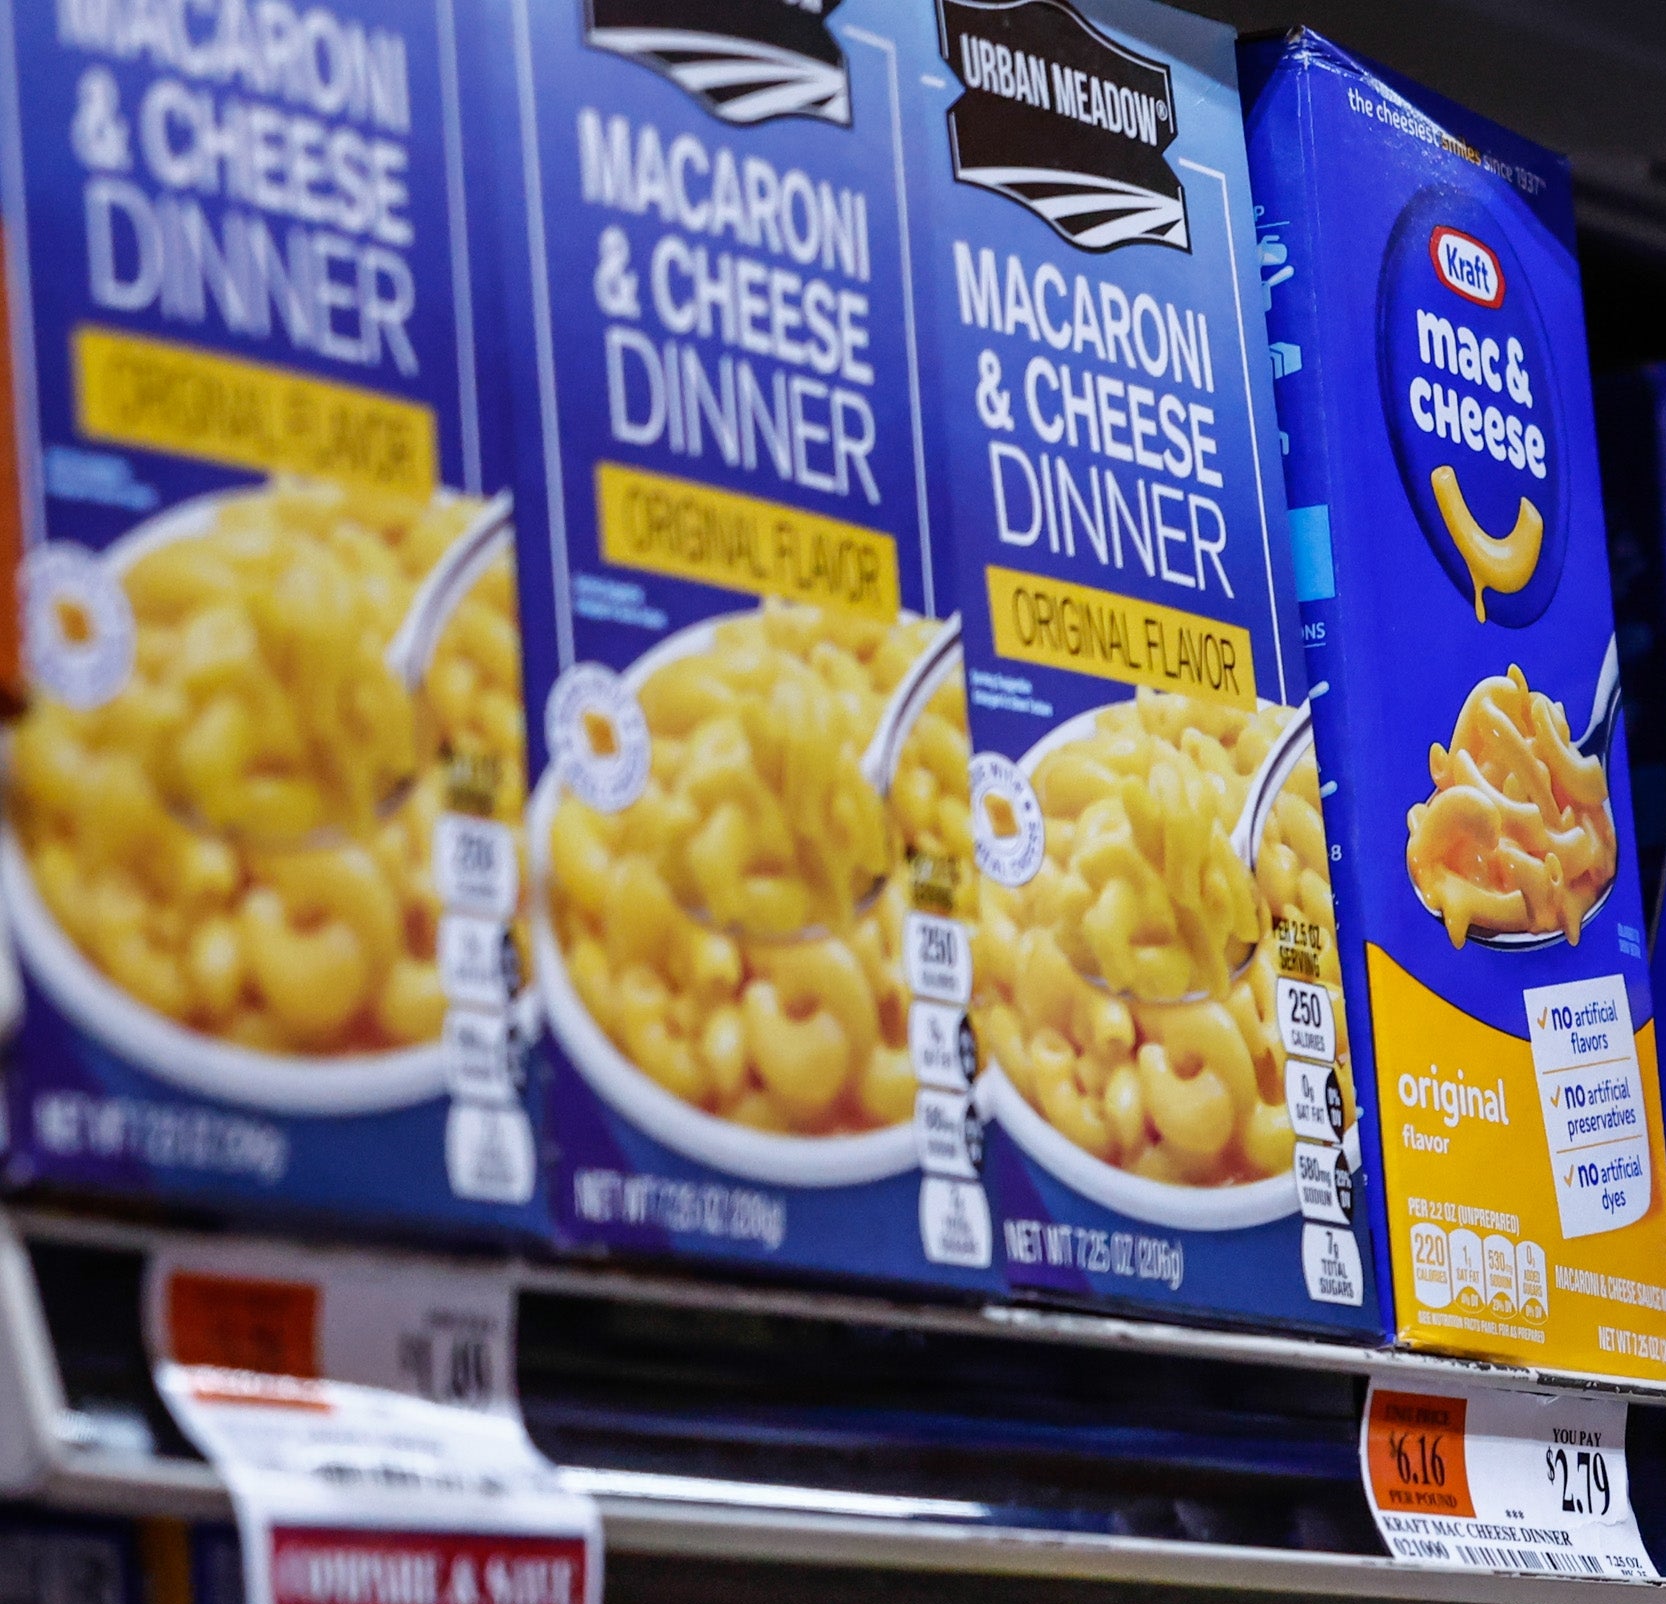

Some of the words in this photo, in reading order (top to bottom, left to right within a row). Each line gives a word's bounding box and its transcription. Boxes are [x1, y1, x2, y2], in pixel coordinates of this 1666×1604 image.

[960, 33, 1049, 110] URBAN
[1348, 88, 1373, 117] the
[1376, 101, 1440, 147] cheesiest
[1483, 150, 1513, 183] since
[70, 66, 132, 172] &
[140, 78, 414, 246] CHEESE
[577, 106, 870, 282] MACARONI
[85, 175, 420, 378] DINNER
[1446, 244, 1490, 294] Kraft
[593, 226, 640, 318] &
[650, 236, 874, 385] CHEESE
[953, 240, 1214, 393] MACARONI
[1416, 308, 1502, 392] mac
[1506, 336, 1532, 409] &
[605, 325, 881, 504] DINNER
[976, 349, 1015, 432] &
[1025, 356, 1224, 488] CHEESE
[989, 440, 1234, 599] DINNER
[1012, 587, 1142, 669] ORIGINAL
[1144, 618, 1240, 696] FLAVOR
[1280, 947, 1320, 978] SERVING
[1288, 987, 1323, 1028] 250
[1551, 1005, 1573, 1031] no
[1574, 999, 1618, 1027] artificial
[1291, 1030, 1326, 1052] CALORIES
[1571, 1032, 1608, 1055] flavors
[1398, 1064, 1510, 1128] original
[1565, 1083, 1586, 1110] no
[1587, 1076, 1631, 1106] artificial
[1402, 1123, 1450, 1155] flavor
[1567, 1107, 1636, 1142] preservatives
[1578, 1161, 1599, 1188] no
[1601, 1155, 1643, 1184] artificial
[1408, 1197, 1428, 1218] PER
[1428, 1200, 1443, 1221] 2.2
[1444, 1203, 1457, 1222] OZ
[1458, 1205, 1520, 1237] (UNPREPARED)
[1602, 1188, 1627, 1216] dyes
[1003, 1218, 1042, 1263] NET
[1414, 1233, 1446, 1266] 220
[1319, 1276, 1353, 1300] SUGARS
[1321, 1257, 1347, 1281] TOTAL
[1555, 1265, 1599, 1297] MACARONI
[1608, 1277, 1636, 1302] CHEESE
[1599, 1326, 1615, 1351] NET
[1616, 1329, 1631, 1353] WT
[1553, 1428, 1577, 1445] YOU
[1579, 1430, 1602, 1447] PAY
[1389, 1430, 1446, 1487] $6.16
[1389, 1489, 1415, 1506] PER
[1416, 1491, 1457, 1509] POUND
[1546, 1446, 1610, 1516] $2.79
[1382, 1515, 1430, 1534] KRAFT
[1435, 1519, 1465, 1538] MAC
[1467, 1522, 1520, 1542] CHEESE
[1521, 1526, 1573, 1547] DINNER
[1393, 1537, 1450, 1560] 021000
